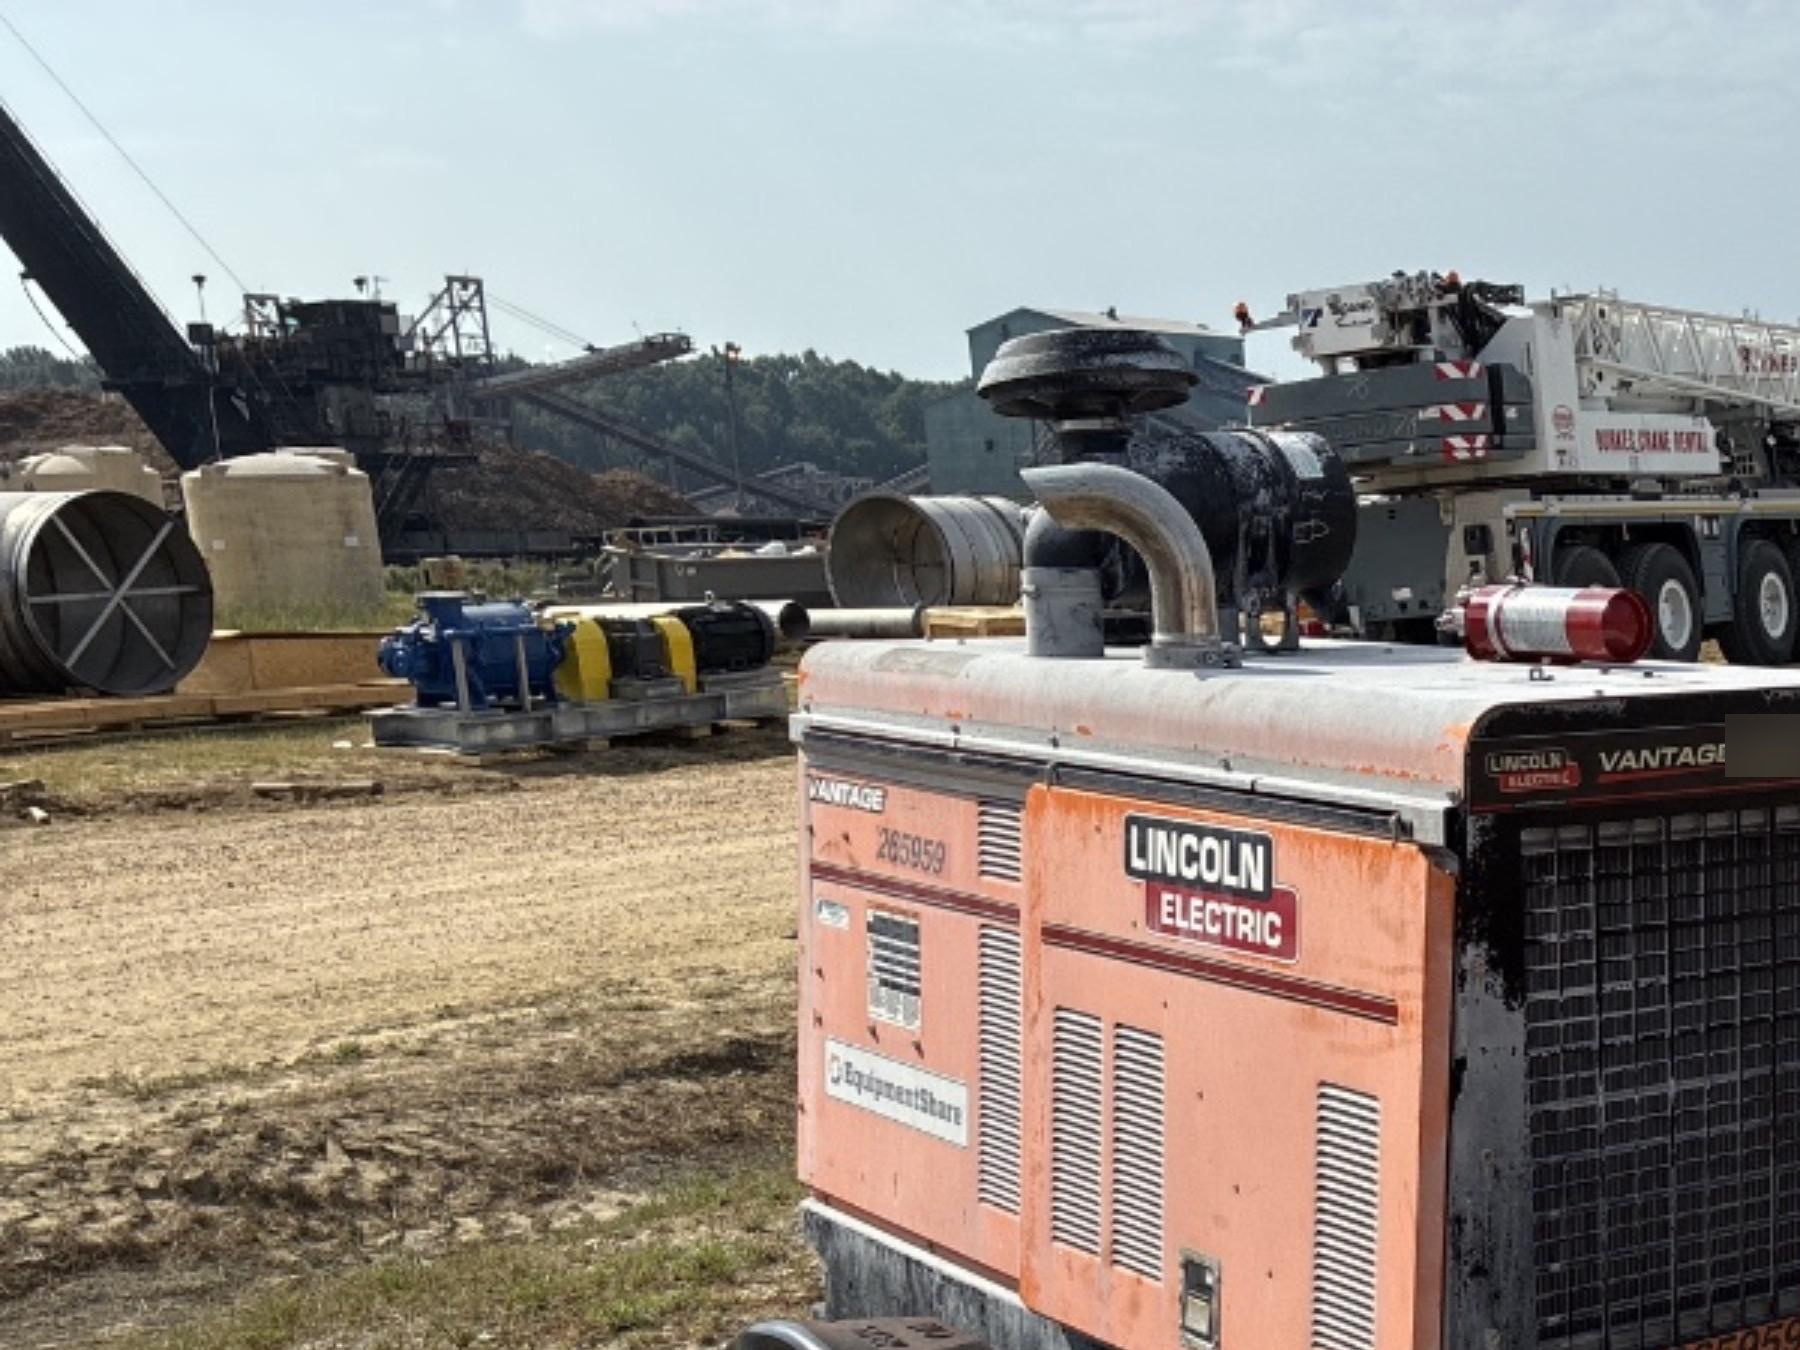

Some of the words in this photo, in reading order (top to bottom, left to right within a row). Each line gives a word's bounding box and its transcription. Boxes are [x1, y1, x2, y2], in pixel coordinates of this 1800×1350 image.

[1489, 751, 1562, 773] LINCOLN
[875, 826, 946, 874] 265959
[1130, 823, 1265, 892] LINCOLN
[1160, 890, 1282, 948] ELECTRIC
[844, 1061, 962, 1126] EquipmentShare
